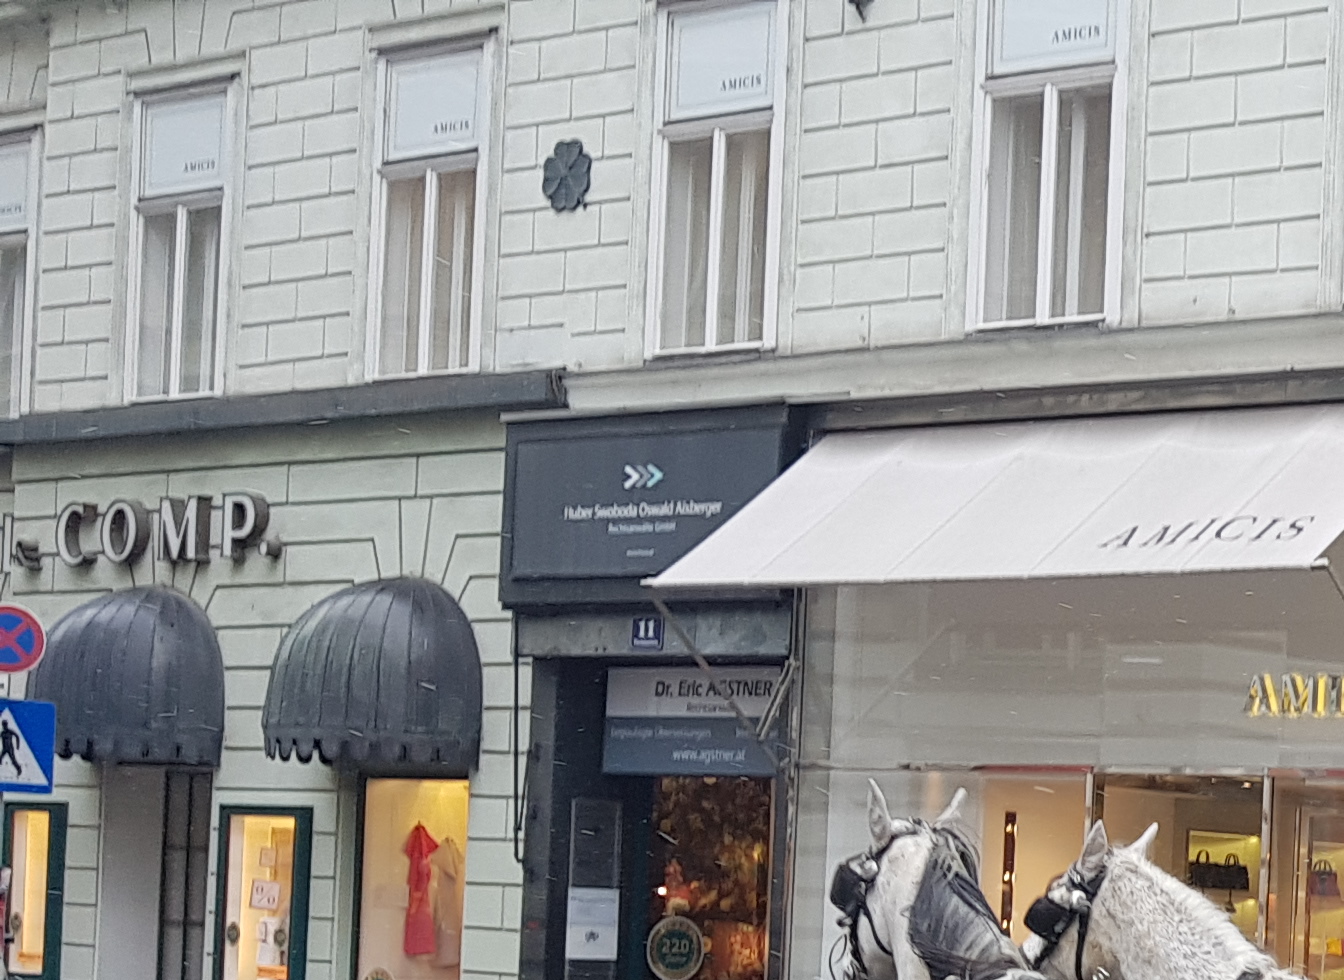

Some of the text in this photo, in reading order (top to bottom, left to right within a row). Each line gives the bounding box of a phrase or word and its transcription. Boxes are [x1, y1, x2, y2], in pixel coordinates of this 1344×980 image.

[1051, 24, 1100, 44] AMICIS
[719, 74, 762, 91] AMICIS
[1098, 515, 1316, 549] AMICIS
[637, 618, 656, 639] 11
[705, 679, 773, 697] ASTNER
